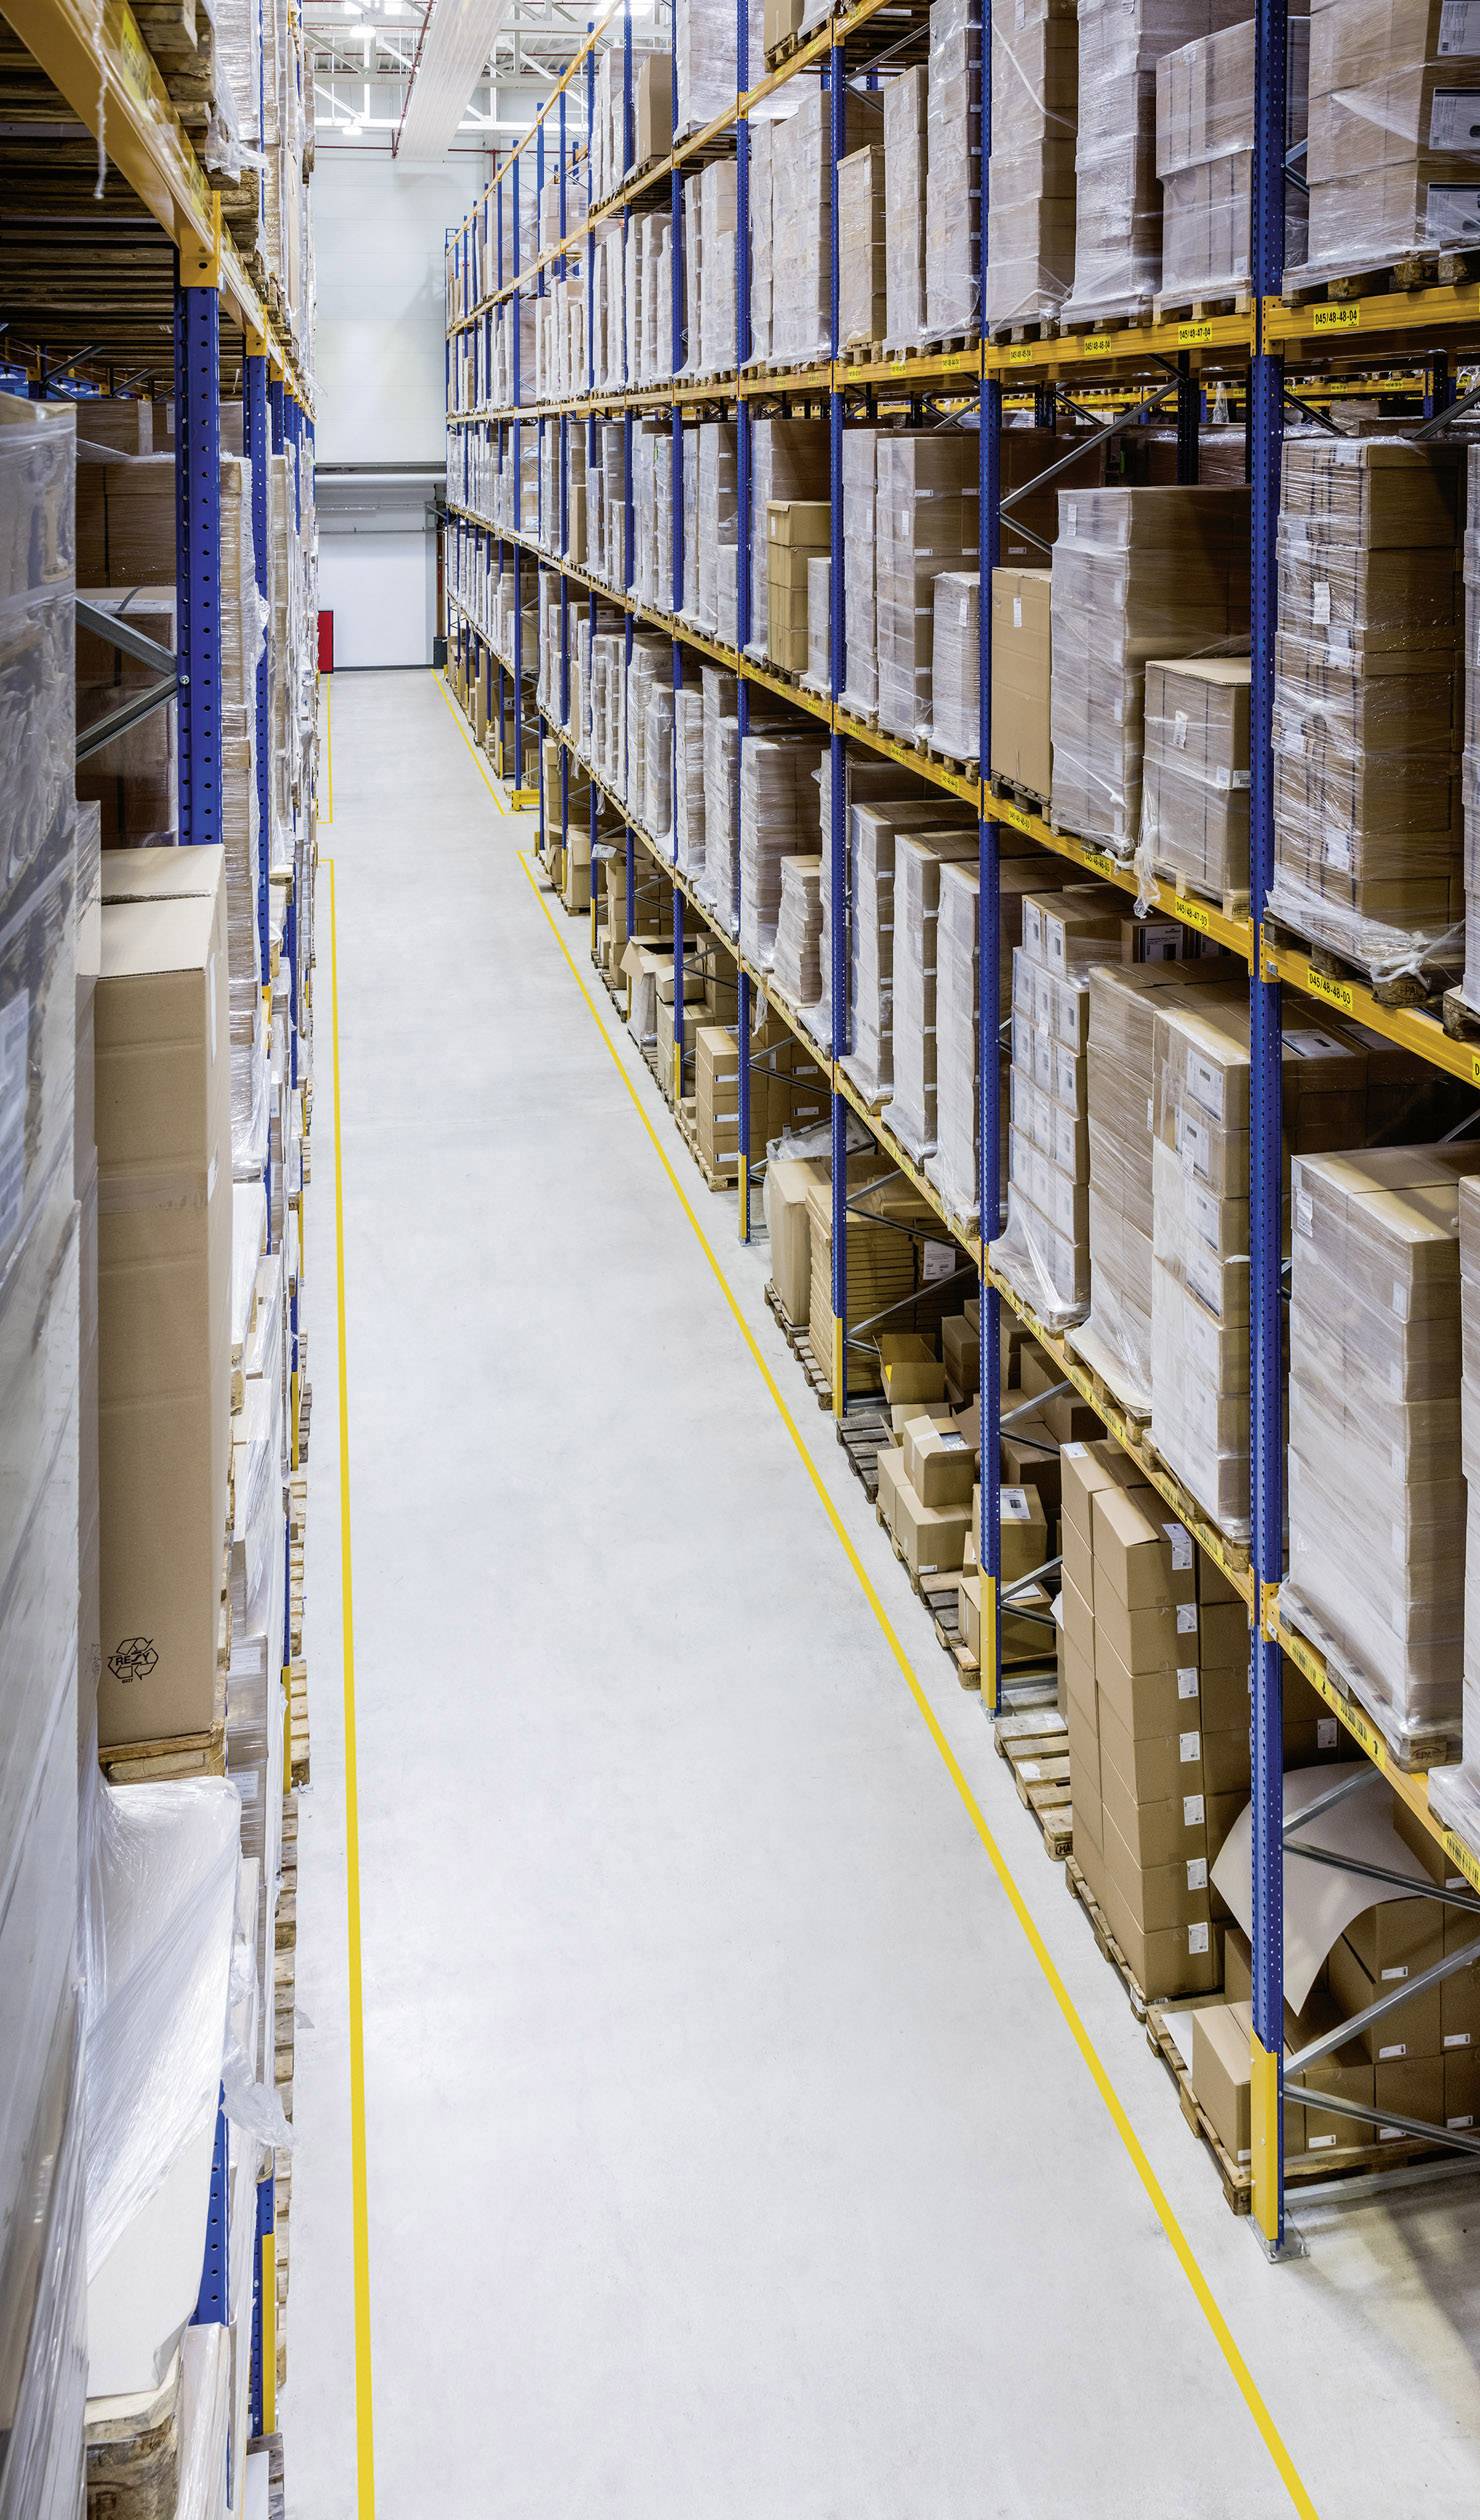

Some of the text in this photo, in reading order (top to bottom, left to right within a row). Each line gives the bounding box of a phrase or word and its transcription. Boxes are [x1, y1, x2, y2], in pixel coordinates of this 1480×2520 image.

[1315, 310, 1358, 325] 045/48-48-04
[1309, 973, 1351, 1004] 045/48-48-03
[115, 1651, 151, 1666] RESY
